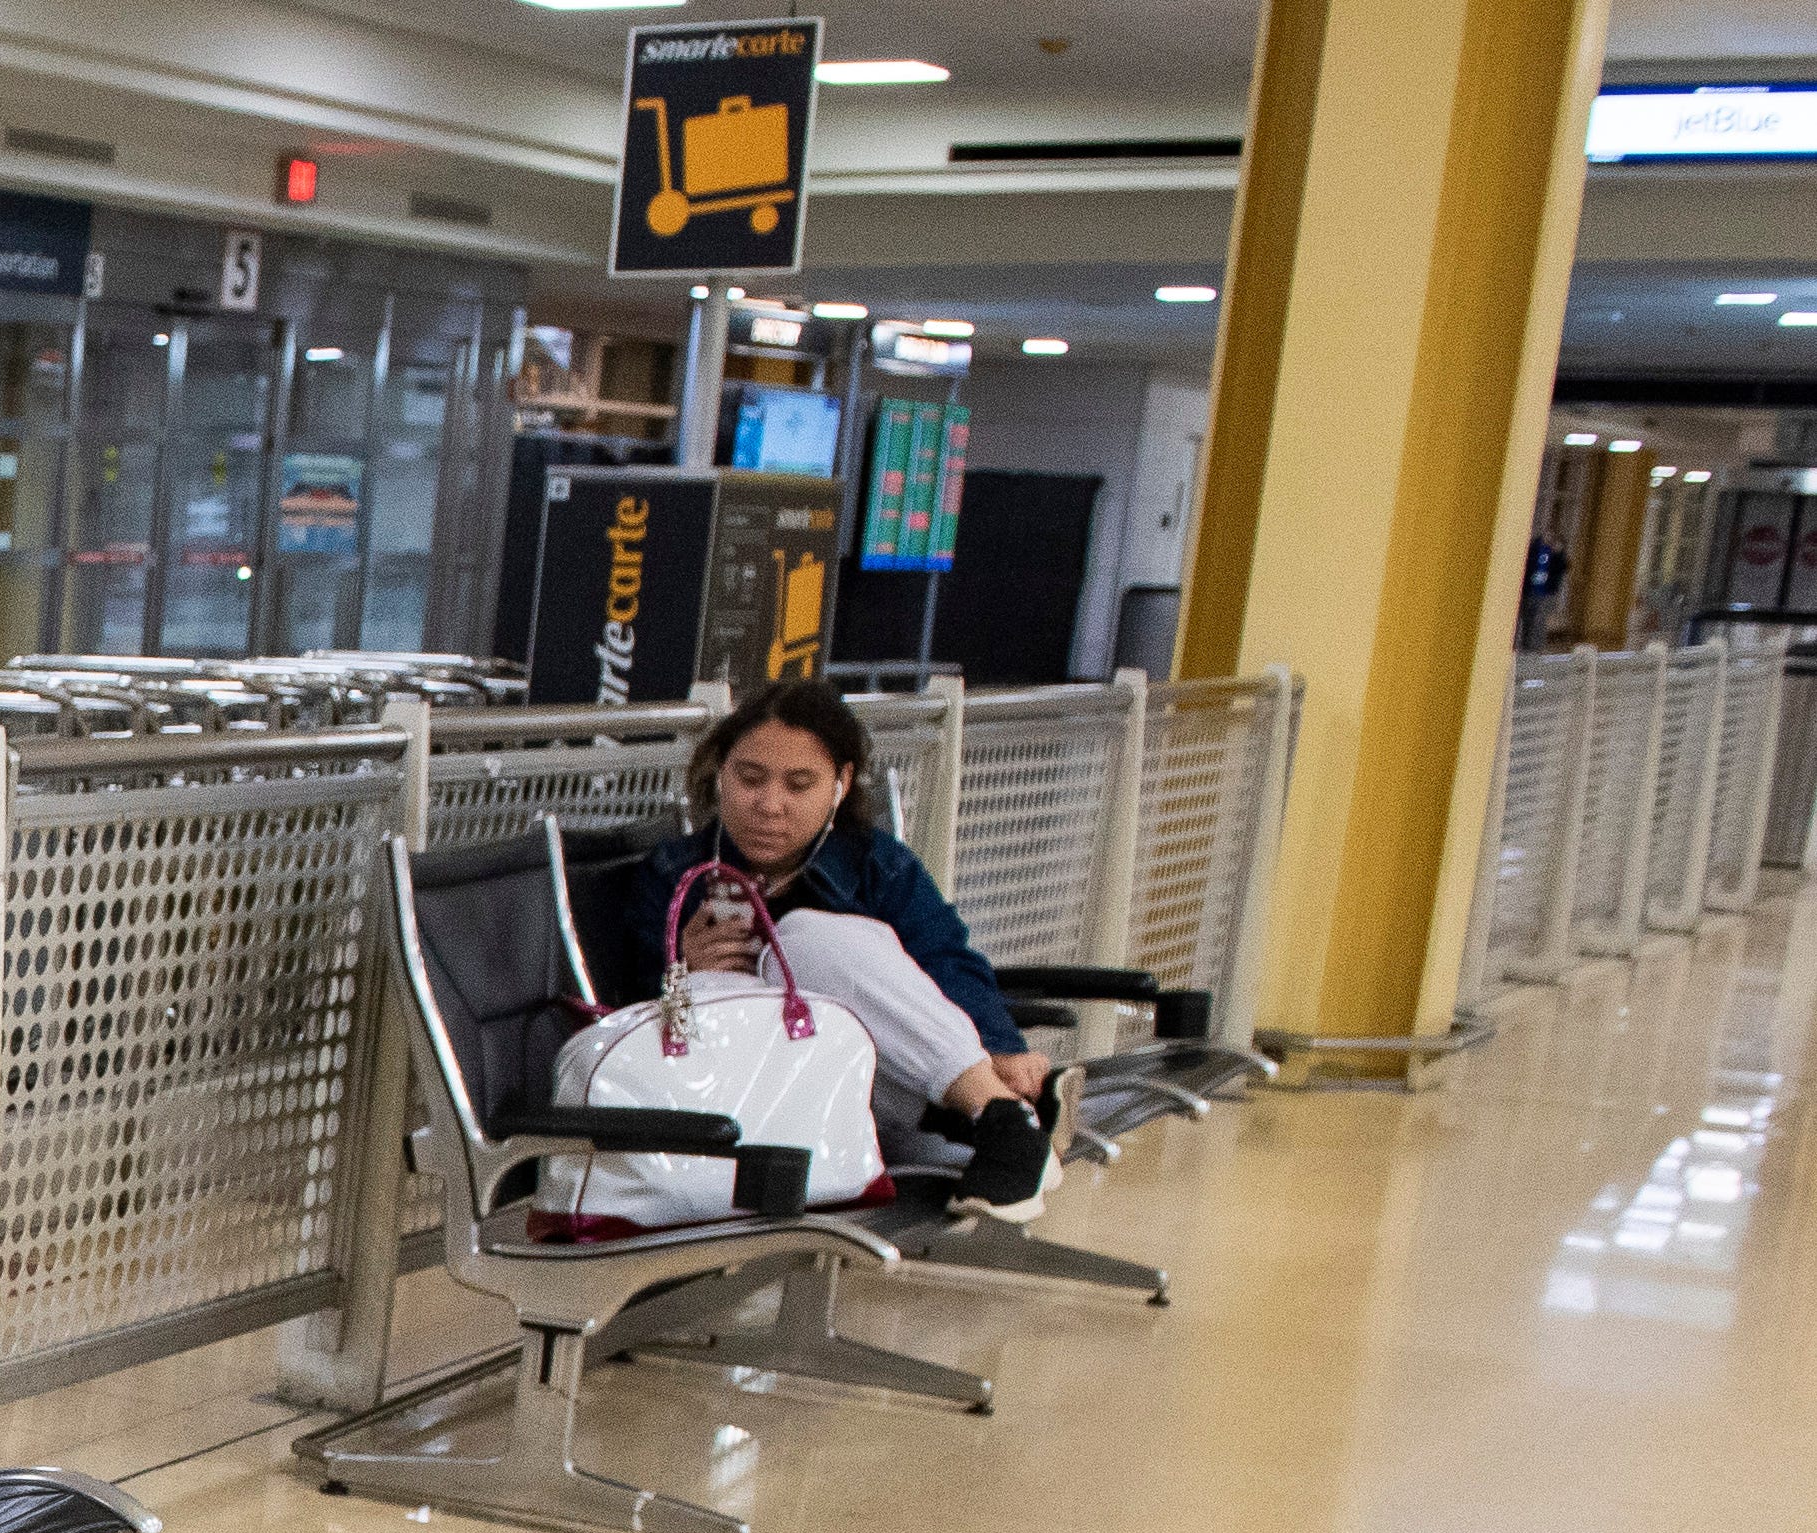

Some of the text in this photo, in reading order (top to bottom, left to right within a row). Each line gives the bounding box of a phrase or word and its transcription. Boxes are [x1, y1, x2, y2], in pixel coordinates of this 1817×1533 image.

[638, 28, 807, 65] smartecarte
[1673, 104, 1782, 140] jetBlue
[228, 239, 255, 300] 5
